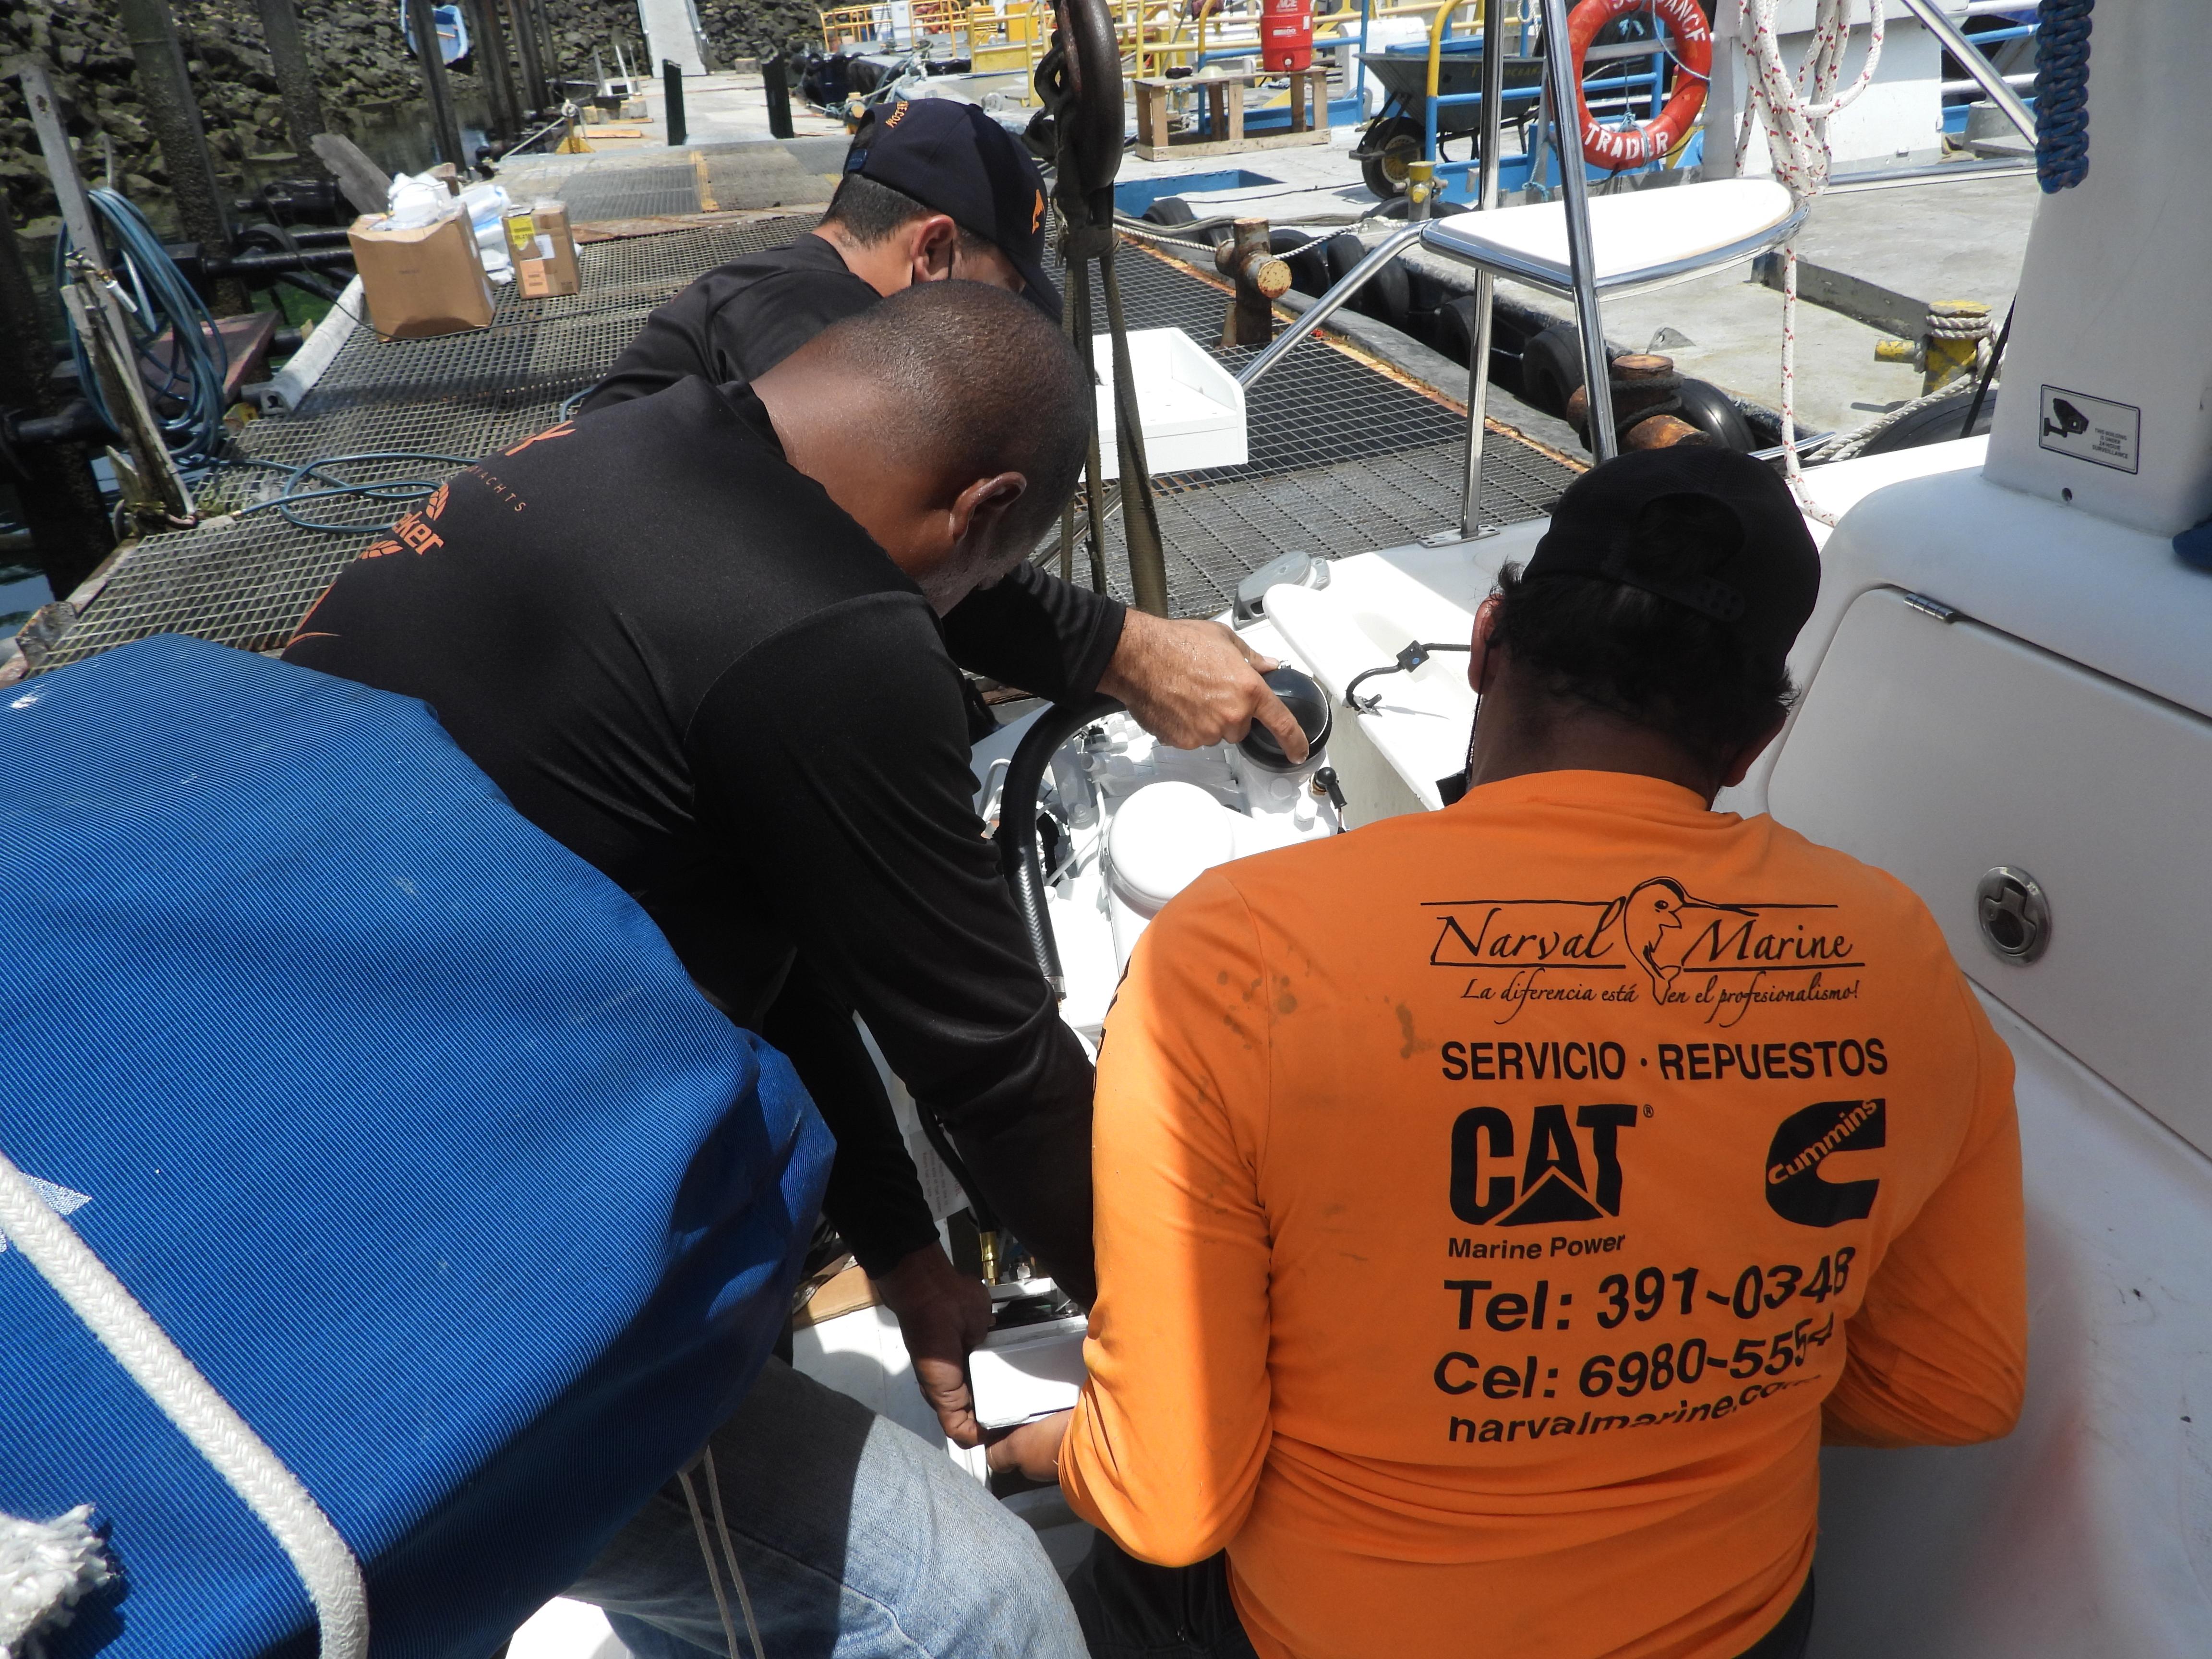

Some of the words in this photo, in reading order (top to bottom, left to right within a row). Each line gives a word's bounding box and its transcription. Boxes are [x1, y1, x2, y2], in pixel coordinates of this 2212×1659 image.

[1585, 122, 1669, 160] TRADER
[1430, 896, 1626, 966] Narval
[1681, 919, 1852, 966] Marine
[1460, 978, 1496, 999] La
[1493, 967, 1597, 1025] diferencia
[1601, 983, 1639, 1003] está
[1667, 991, 1690, 1003] en
[1695, 975, 1715, 1003] el
[1704, 970, 1860, 1028] profesionalismo!
[1442, 1041, 1626, 1081] SERVICIO
[1658, 1037, 1888, 1081] REPUESTOS
[1449, 1104, 1638, 1227] CAT
[1768, 1101, 1877, 1185] Cummins
[1448, 1237, 1542, 1259] Marine
[1550, 1234, 1626, 1257] Power
[1443, 1279, 1573, 1332] Tel:
[1597, 1246, 1856, 1330] 391-0348
[1433, 1351, 1559, 1399] Cel:
[1579, 1311, 1835, 1398] 6980-5554
